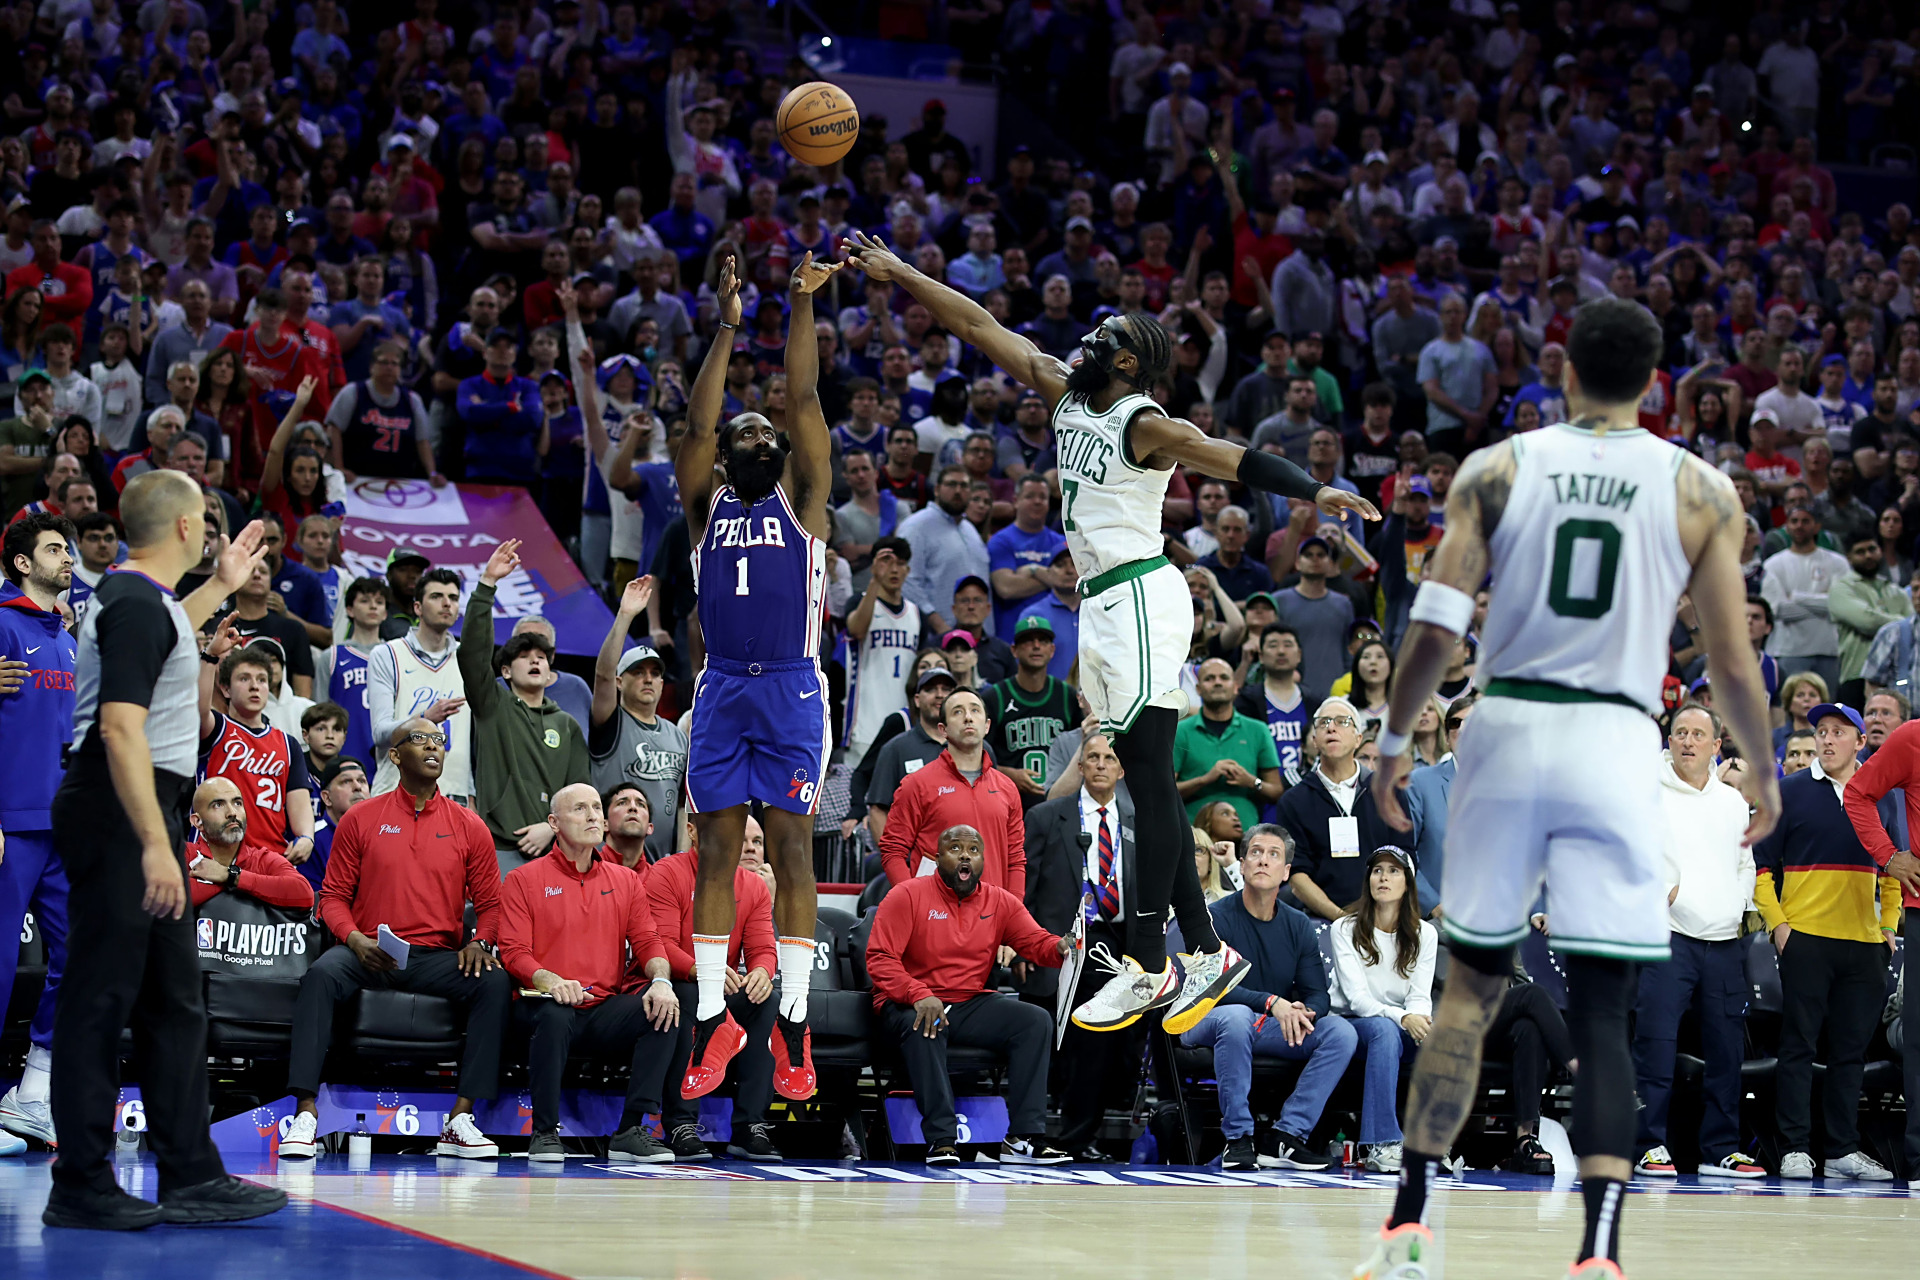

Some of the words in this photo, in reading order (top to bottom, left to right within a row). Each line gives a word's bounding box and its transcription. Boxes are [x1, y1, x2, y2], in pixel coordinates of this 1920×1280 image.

[809, 116, 857, 136] Wilson
[372, 427, 400, 453] 21
[1057, 429, 1114, 485] CELTICS
[1062, 478, 1079, 532] 7
[1548, 474, 1638, 513] TATUM
[710, 516, 786, 552] PHILA
[735, 556, 750, 596] 1
[1547, 518, 1622, 620] 0
[893, 654, 900, 678] 1
[217, 739, 286, 777] Phila
[1023, 750, 1047, 784] 0
[256, 777, 282, 813] 21
[786, 777, 815, 803] 76
[938, 786, 956, 796] Phila
[379, 824, 401, 836] Phila
[544, 886, 563, 898] Phila
[928, 909, 949, 921] Phila
[216, 920, 307, 956] PLAYOFFS
[223, 954, 253, 966] Google
[254, 957, 274, 966] Pixel
[376, 1104, 420, 1136] 76
